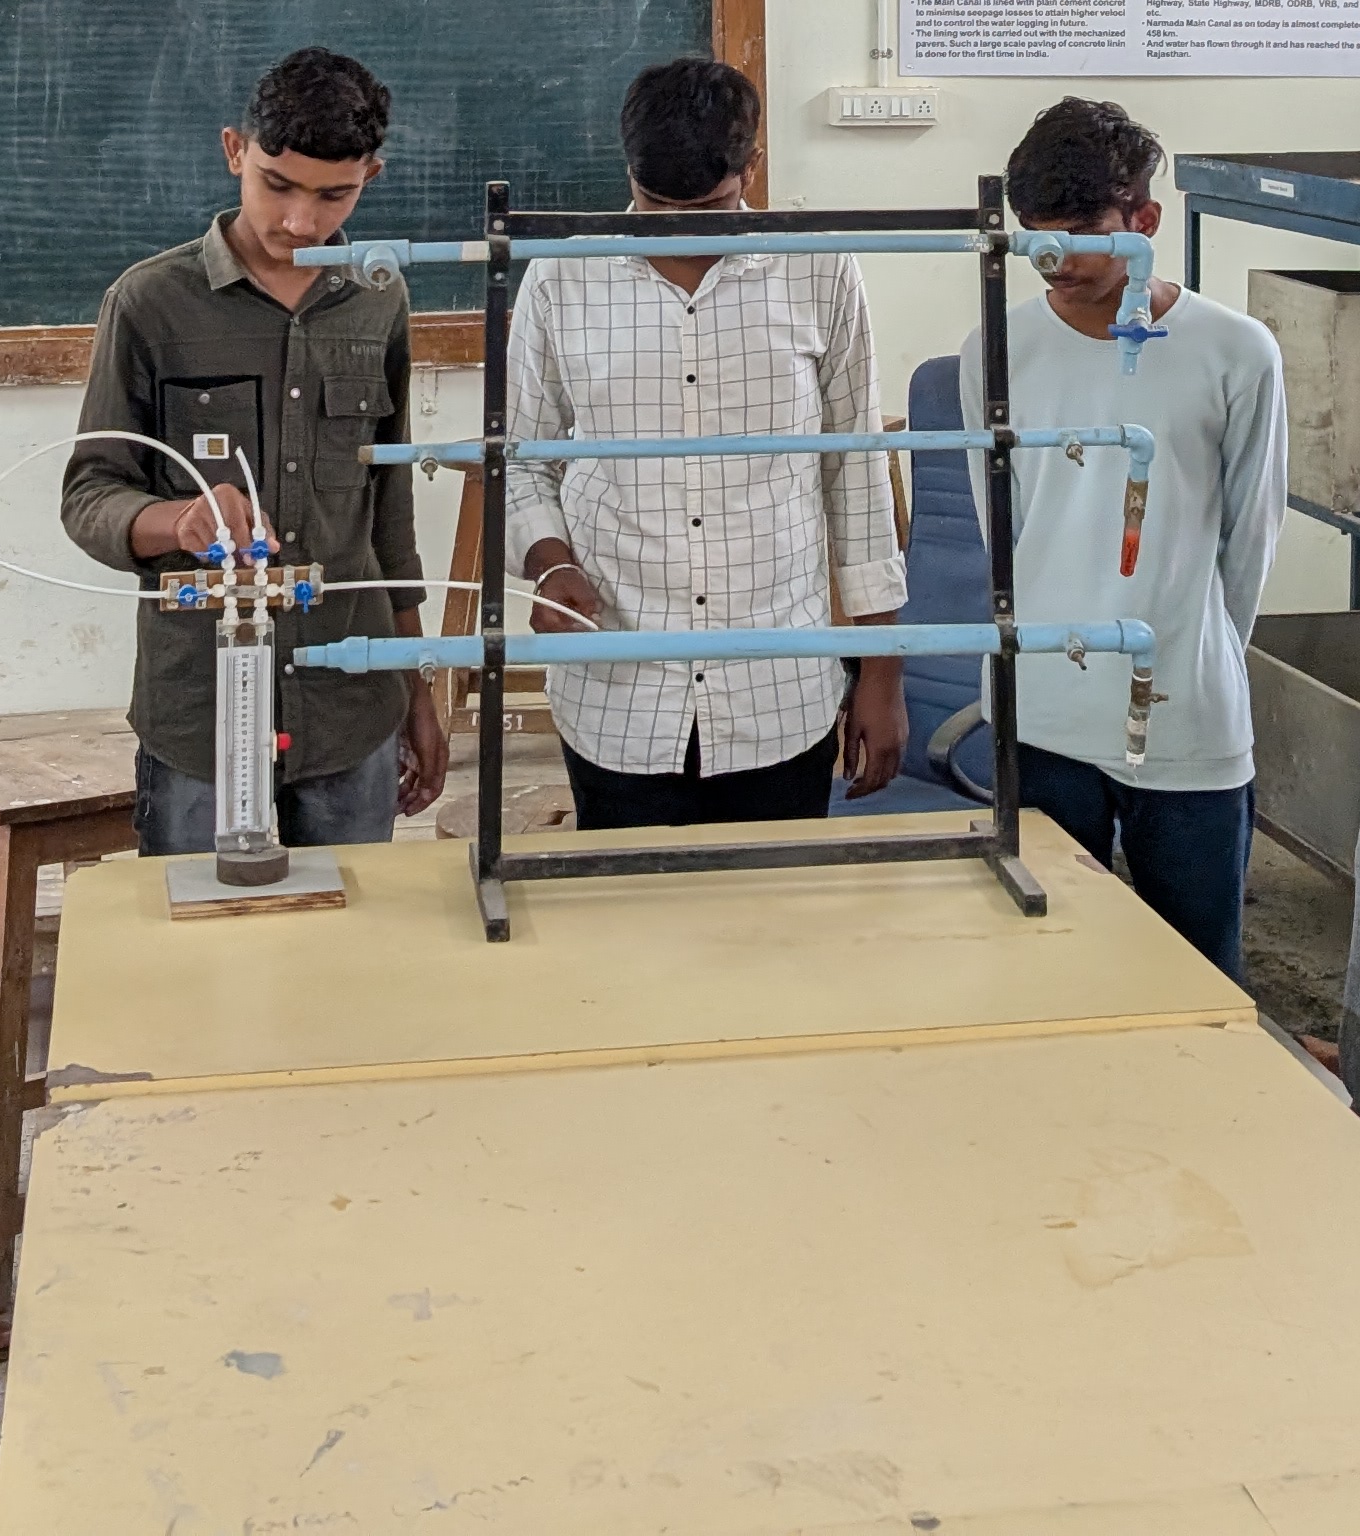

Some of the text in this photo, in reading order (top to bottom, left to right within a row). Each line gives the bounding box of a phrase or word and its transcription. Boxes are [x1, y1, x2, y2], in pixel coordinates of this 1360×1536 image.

[1342, 0, 1359, 8] and
[915, 28, 1125, 39] The lining work is carried out with the mechanized
[915, 49, 1049, 57] is done for the first time in India.
[1146, 49, 1191, 60] Rajasthan.
